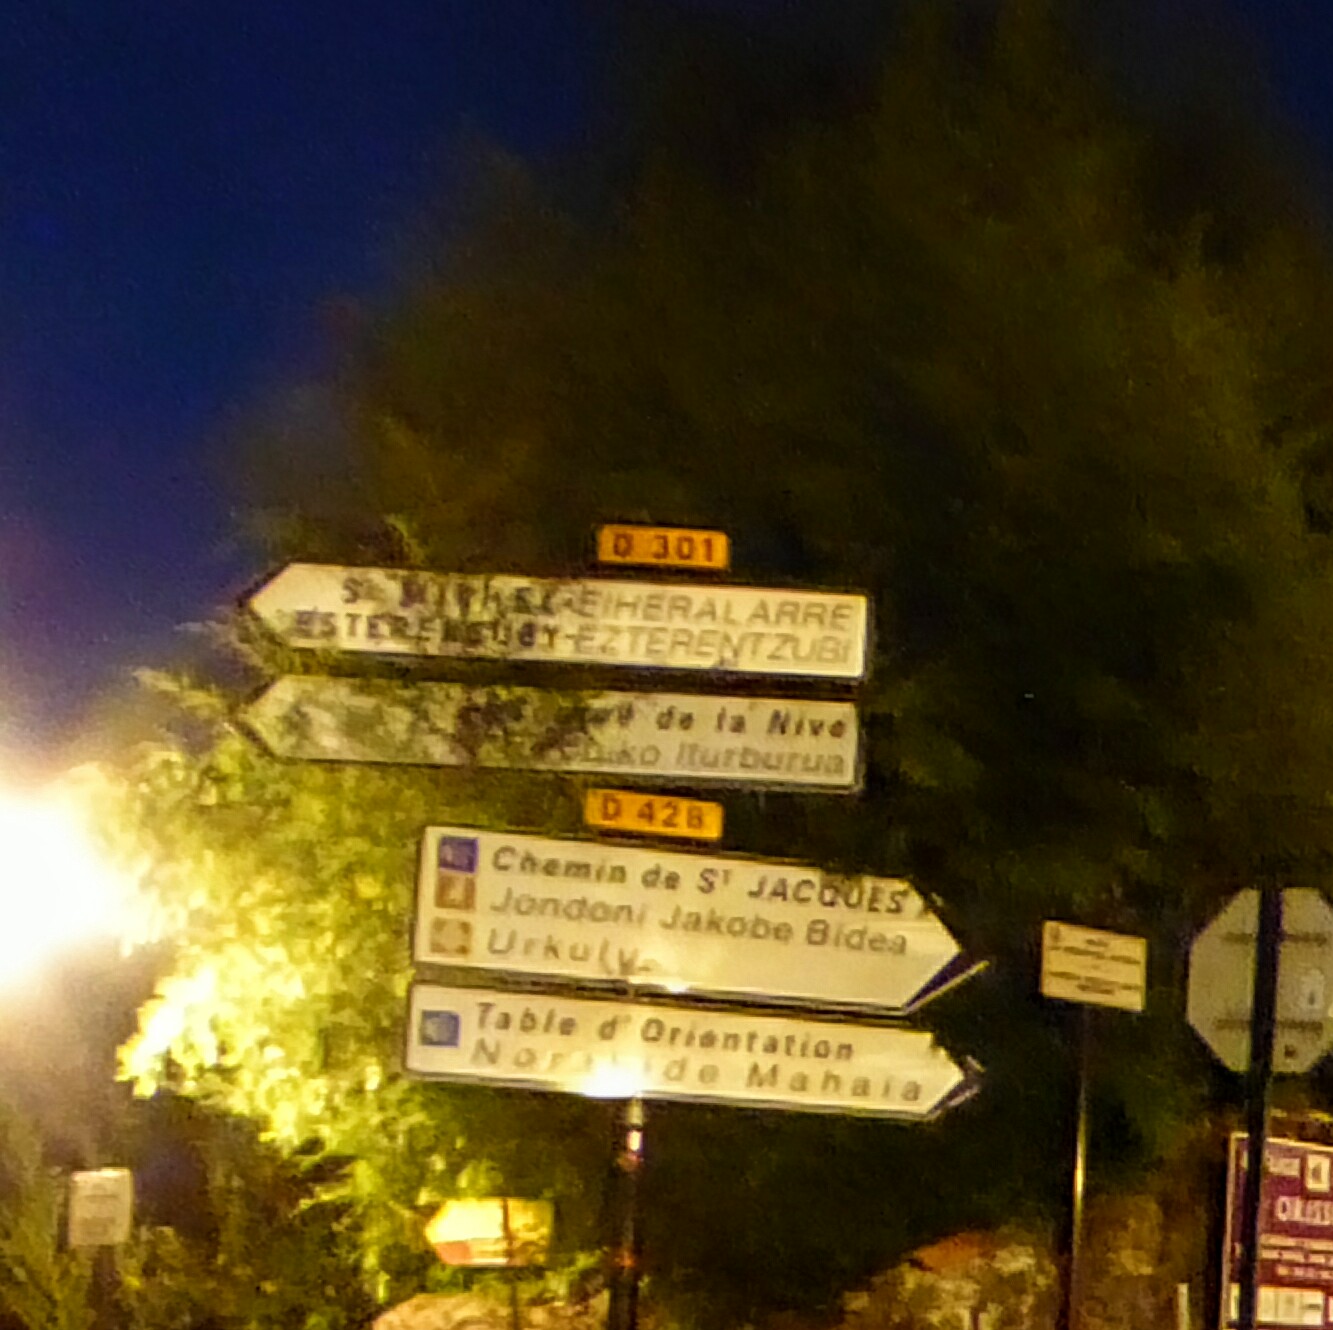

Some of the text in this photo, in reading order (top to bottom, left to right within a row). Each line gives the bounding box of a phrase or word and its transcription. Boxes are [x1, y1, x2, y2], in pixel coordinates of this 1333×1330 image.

[613, 532, 714, 563] D 301
[656, 704, 695, 732] de
[716, 706, 747, 734] la
[767, 708, 847, 739] Nive
[602, 792, 706, 830] D 428
[491, 844, 628, 885] Chemin
[641, 862, 681, 891] de
[747, 874, 910, 915] JACQUES
[659, 903, 794, 944] Jakobe
[805, 917, 908, 956] Bidea
[475, 1001, 578, 1037] Table
[745, 1061, 923, 1102] Mahaia
